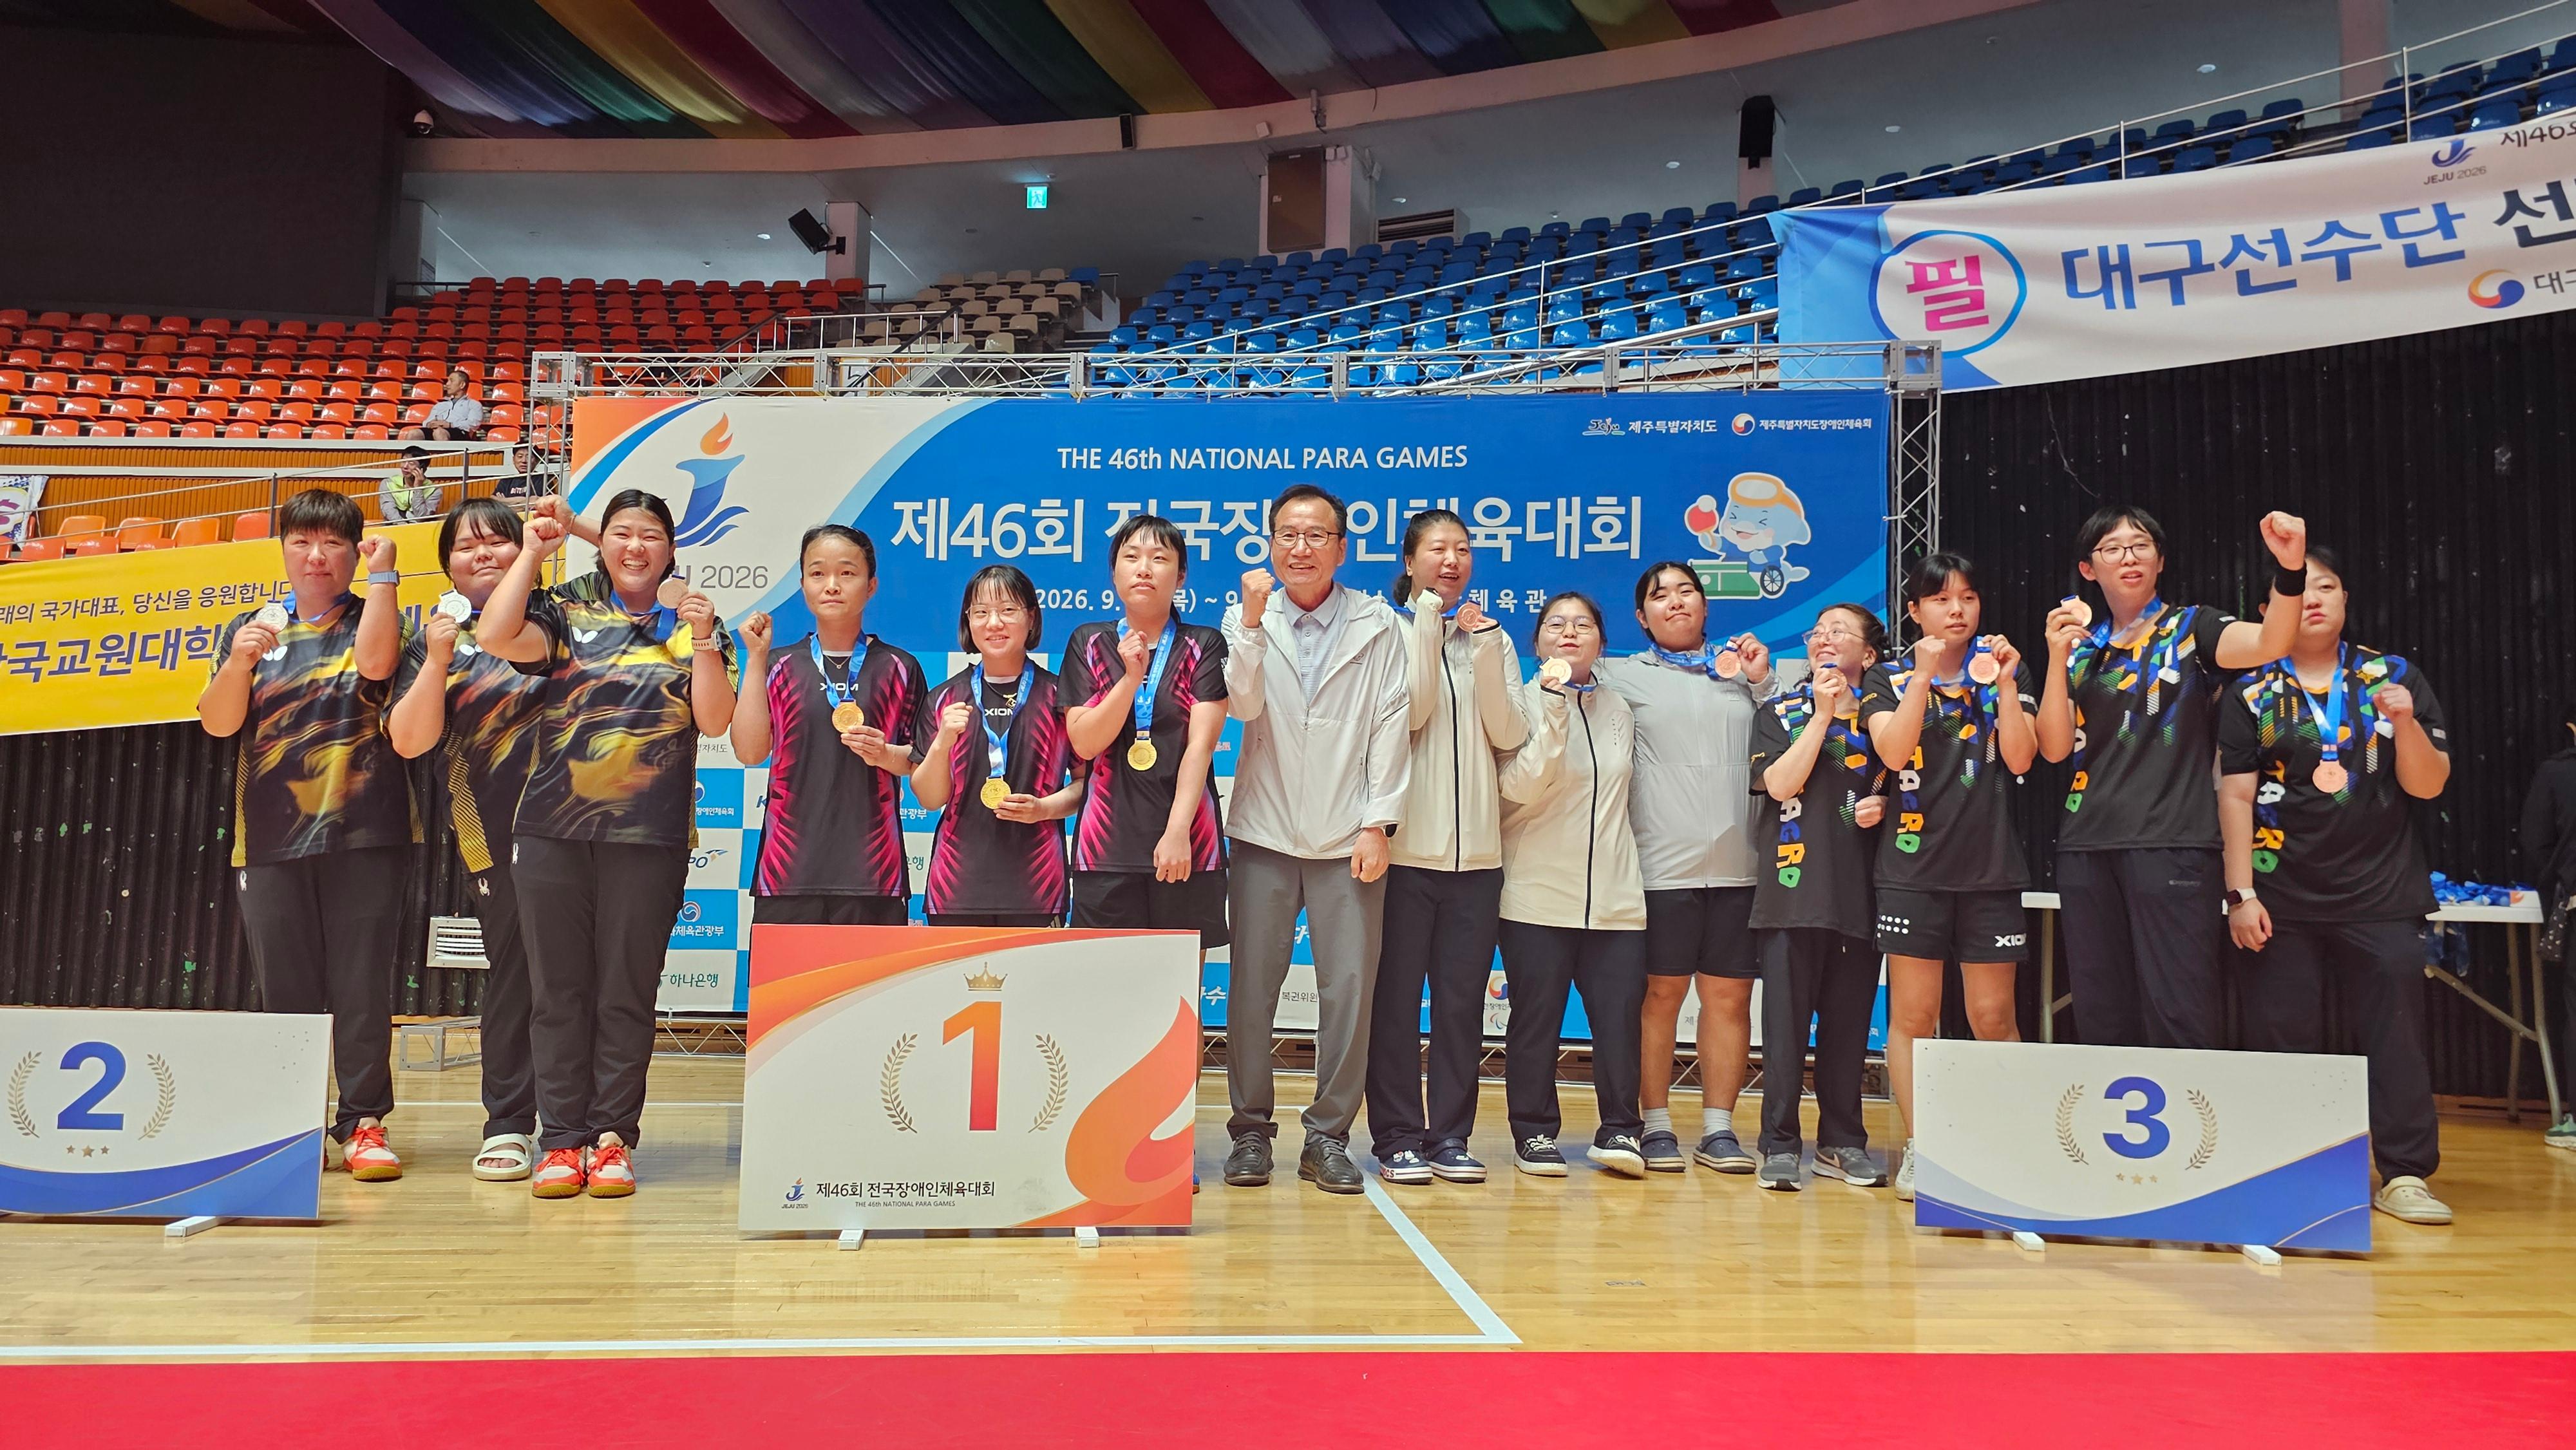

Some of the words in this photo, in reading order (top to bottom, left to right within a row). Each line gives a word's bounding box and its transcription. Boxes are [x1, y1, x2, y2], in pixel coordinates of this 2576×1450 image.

[2423, 172, 2454, 185] JEJU
[2457, 165, 2487, 179] 2026
[2060, 202, 2466, 310] 대구선수단
[2492, 179, 2576, 249] 선
[1905, 254, 1990, 332] 필
[1628, 419, 1718, 434] 제주특별자치도
[1759, 418, 1873, 431] 제주특별자치도장애인체육회
[1057, 448, 1102, 469] THE
[1108, 447, 1162, 469] 46th
[1170, 447, 1295, 469] NATIONAL
[1302, 448, 1369, 469] PARA
[1376, 445, 1468, 469] GAMES
[891, 497, 1085, 563] 제46회
[700, 565, 769, 589] 2026
[40, 596, 125, 622] 국가대표,
[133, 589, 193, 615] 당신을
[1036, 588, 1094, 611] 2026.
[1101, 590, 1121, 611] 9.
[0, 623, 222, 683] 국교원대학
[1776, 797, 1805, 888] AGRO
[1994, 933, 2027, 947] XIO
[670, 973, 719, 988] 하나은행
[942, 1001, 1002, 1131] 1
[57, 1041, 127, 1131] 2
[2102, 1076, 2171, 1159] 3
[816, 1182, 863, 1198] 제46회
[867, 1181, 996, 1198] 전국장애인체육대회
